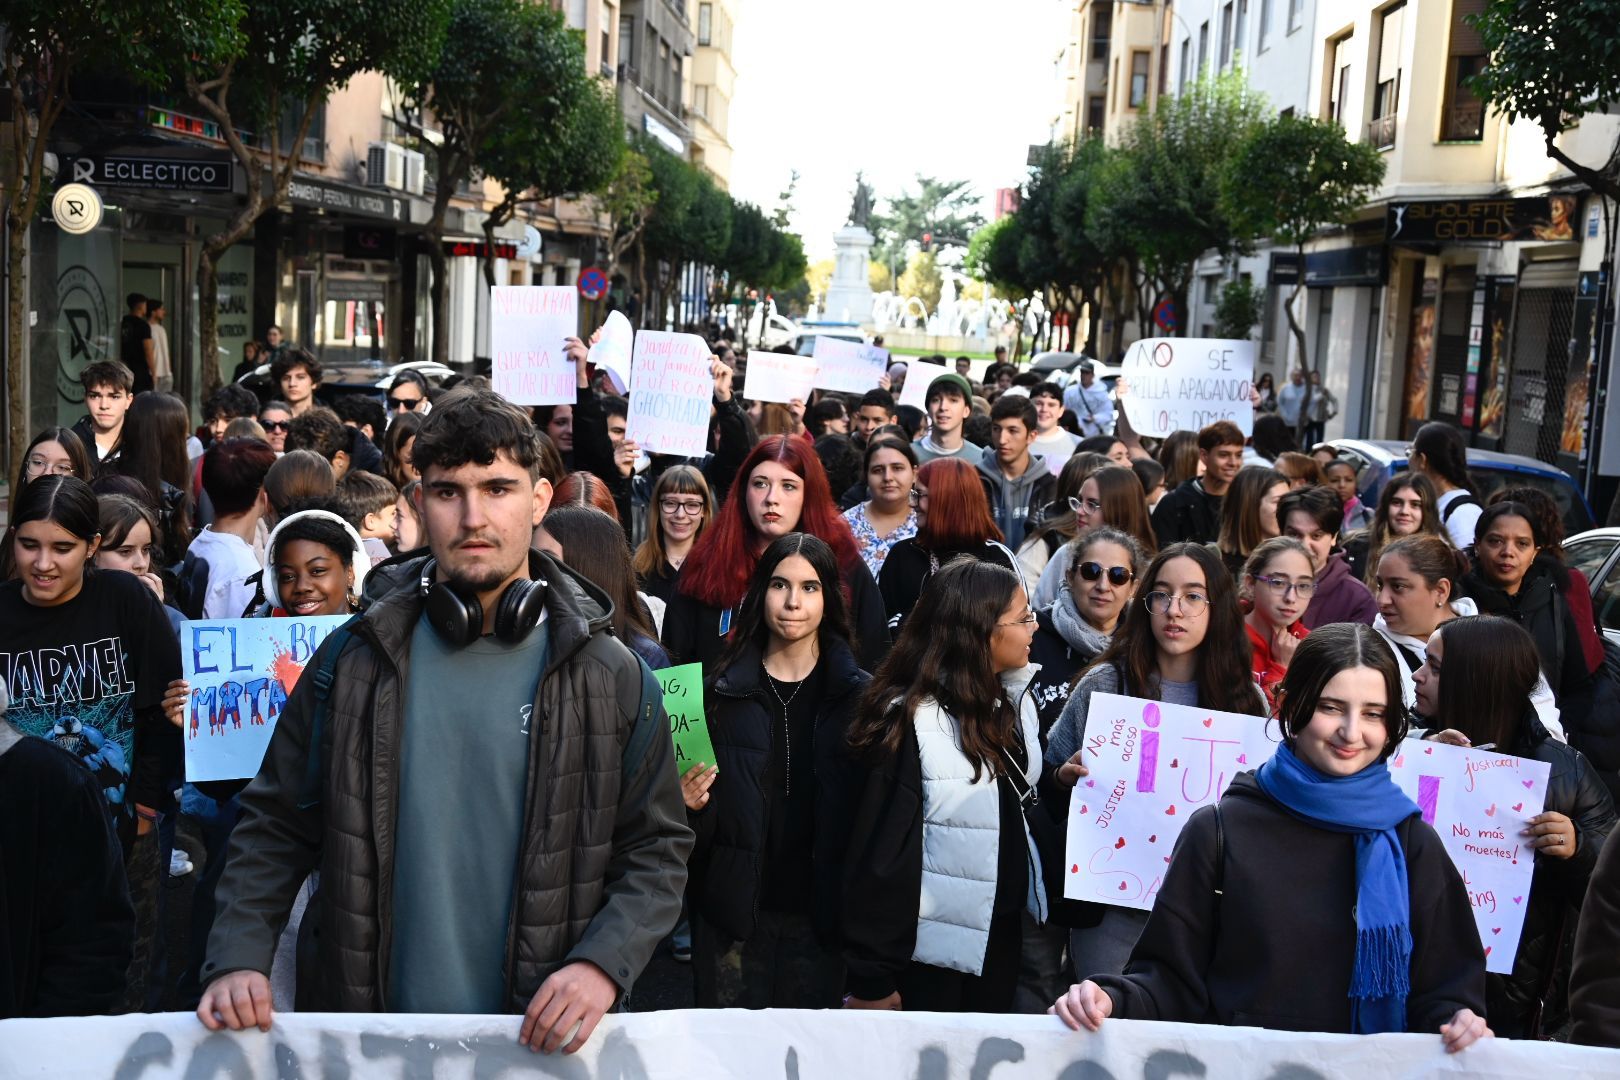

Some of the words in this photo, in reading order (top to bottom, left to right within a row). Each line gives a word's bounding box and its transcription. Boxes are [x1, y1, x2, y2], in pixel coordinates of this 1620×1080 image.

[104, 162, 216, 183] ECLECTICO
[1408, 202, 1515, 218] SILHOUETTE
[1435, 219, 1502, 238] GOLD
[496, 288, 520, 315] NO
[1136, 342, 1173, 367] NO
[1208, 349, 1234, 371] SE
[1130, 376, 1170, 400] RILLA
[1152, 409, 1179, 433] LOS
[191, 626, 253, 675] EL
[190, 677, 288, 739] MATA
[1110, 718, 1126, 747] más
[1121, 726, 1138, 762] acoso
[1086, 733, 1107, 757] No
[1096, 779, 1127, 828] JUSTICIA
[1452, 823, 1470, 837] No
[1478, 826, 1505, 840] más
[1464, 843, 1518, 865] muertes!
